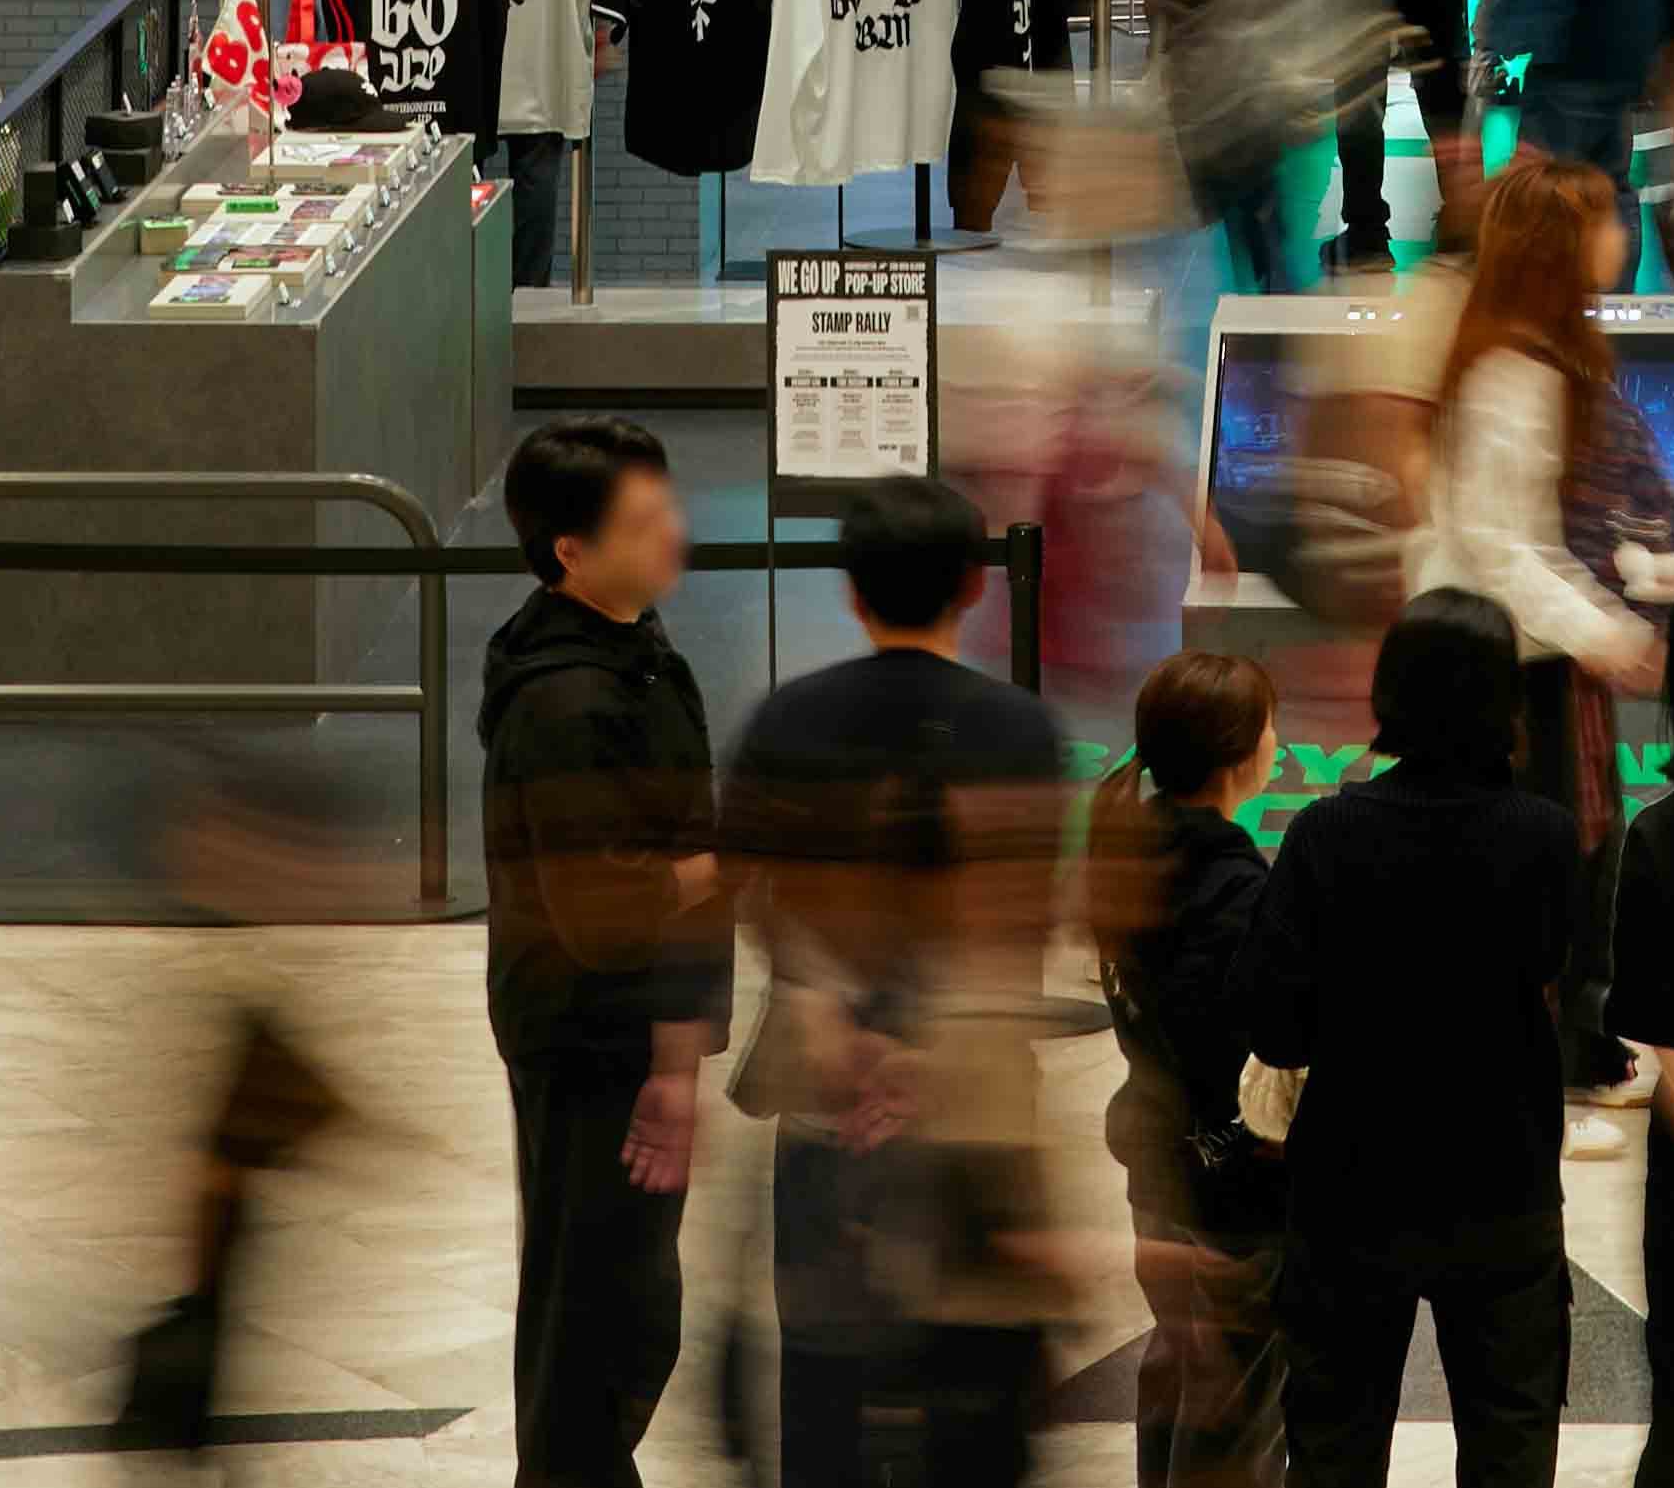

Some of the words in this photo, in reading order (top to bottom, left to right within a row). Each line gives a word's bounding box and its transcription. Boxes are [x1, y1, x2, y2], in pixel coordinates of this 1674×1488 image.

[778, 260, 799, 295] WE
[801, 260, 820, 295] GO
[821, 260, 839, 295] UP
[845, 272, 888, 296] POP-UP
[890, 272, 926, 296] STORE
[812, 311, 853, 335] STAMP
[855, 311, 892, 335] RALLY
